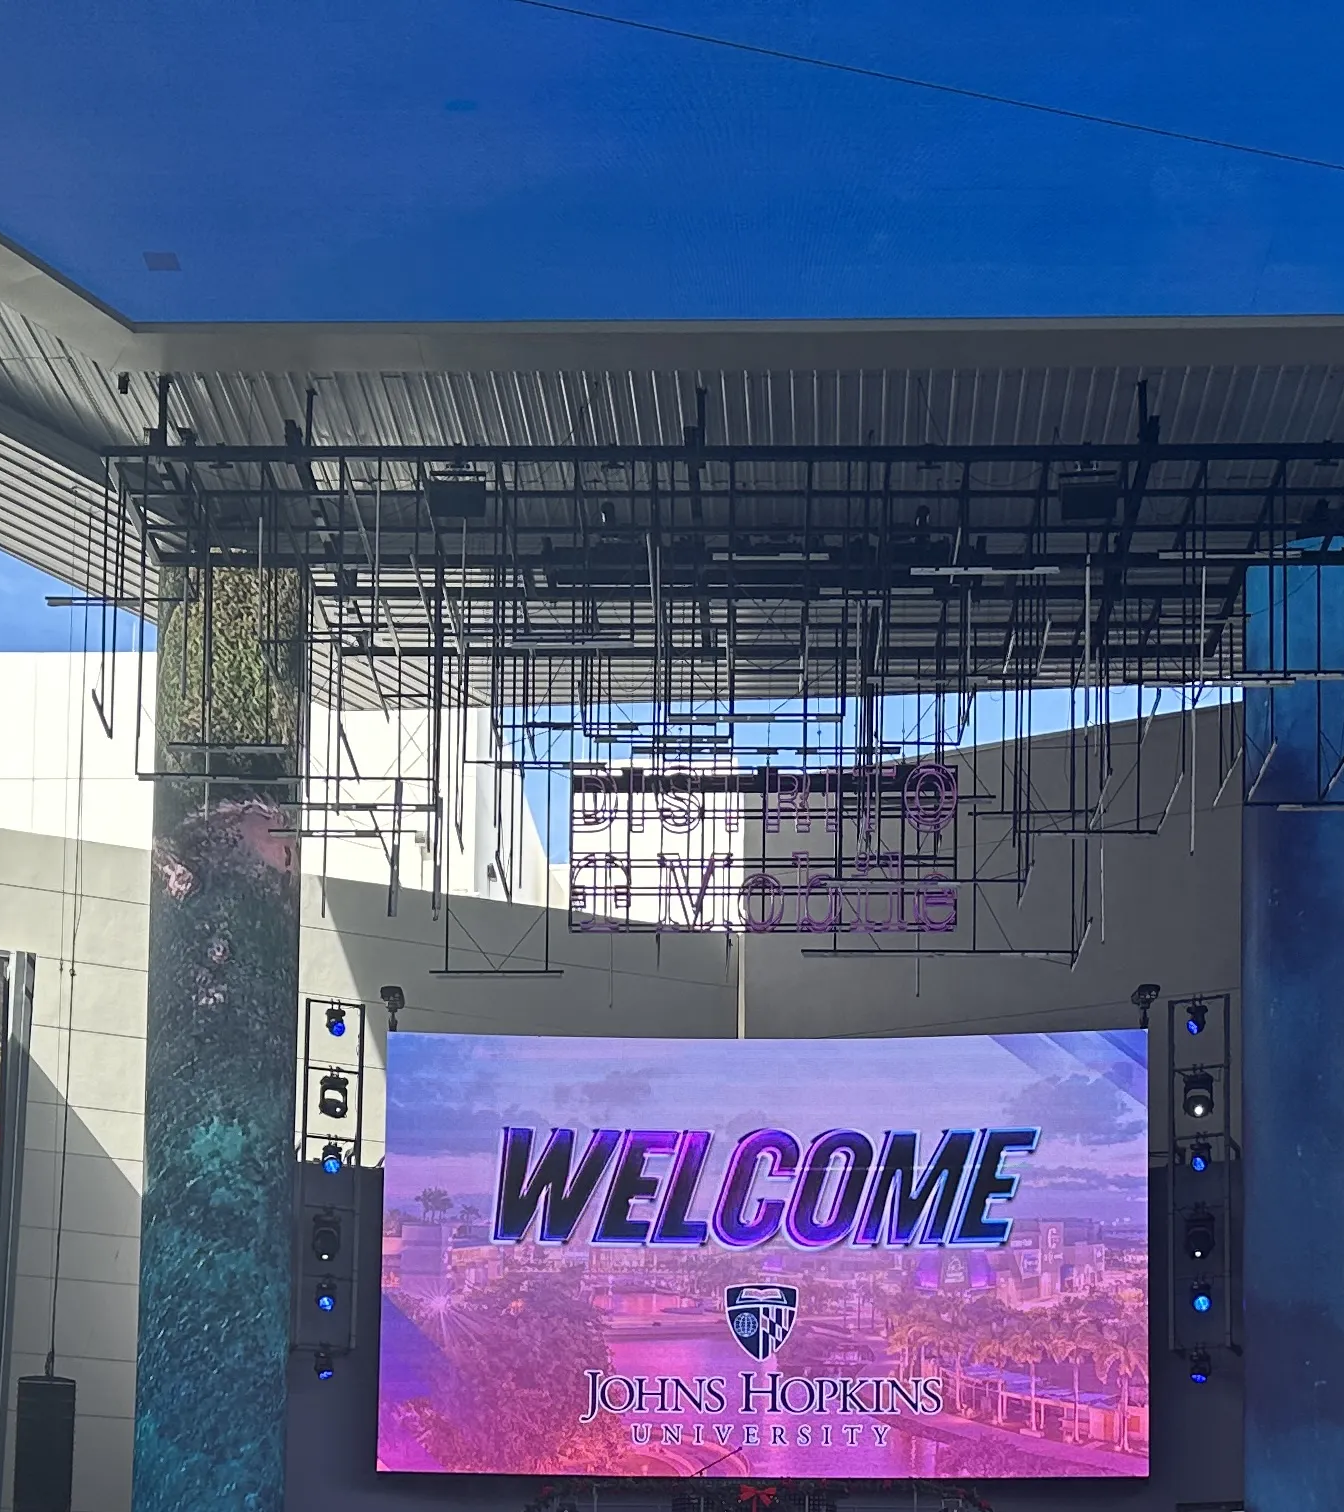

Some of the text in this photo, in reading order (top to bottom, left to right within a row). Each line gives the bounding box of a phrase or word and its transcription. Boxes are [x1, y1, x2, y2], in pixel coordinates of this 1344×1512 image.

[572, 763, 958, 834] DISTRITO
[492, 1125, 1042, 1250] WELCOME
[580, 1370, 944, 1422] JOHNS HOPKINS
[631, 1424, 891, 1446] UNIVERSITY
